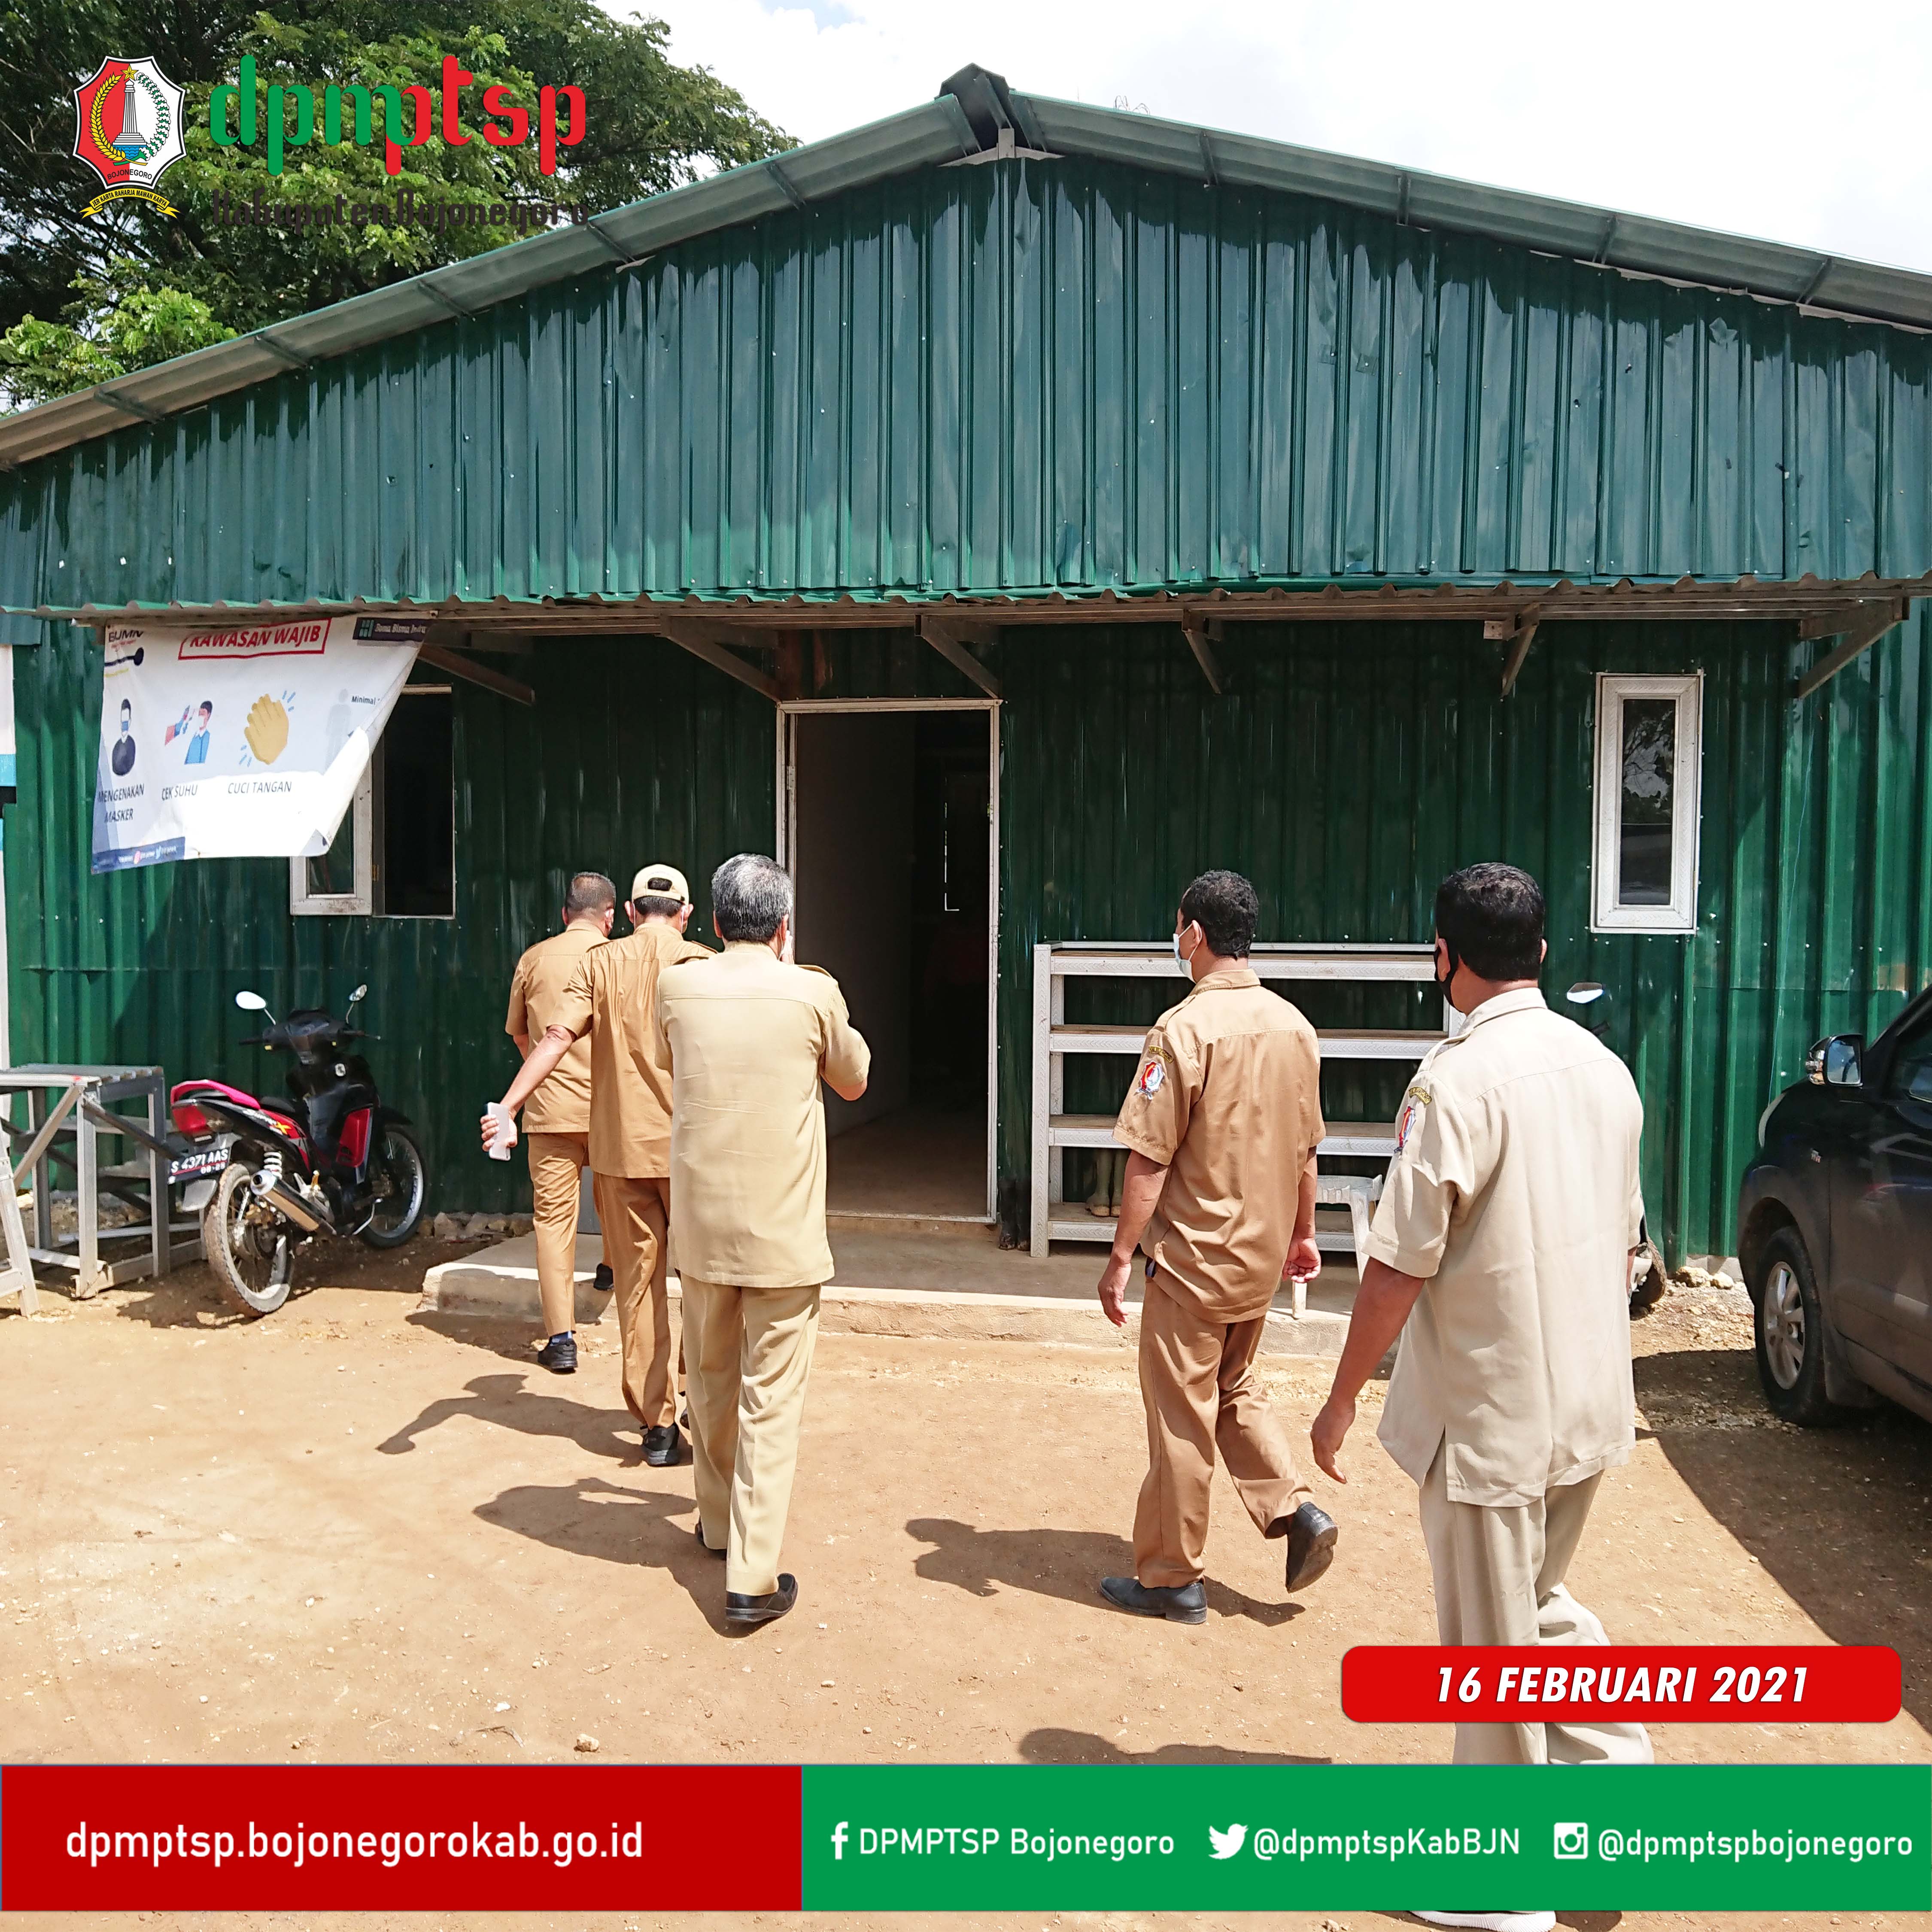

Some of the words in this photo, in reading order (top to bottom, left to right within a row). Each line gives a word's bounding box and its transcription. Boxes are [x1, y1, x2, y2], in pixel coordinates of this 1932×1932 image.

[190, 630, 272, 648] KAWASAN
[273, 625, 322, 647] WAJIB
[351, 696, 376, 705] Minimal
[97, 783, 144, 802] MENGENAKAN
[161, 787, 173, 801] CEK
[174, 784, 198, 797] SUHU
[228, 782, 249, 794] CUCI
[252, 781, 292, 793] TANGAN
[104, 808, 134, 823] MASKER
[171, 1160, 179, 1173] S
[181, 1153, 207, 1170] 4371
[207, 1148, 228, 1163] AAS
